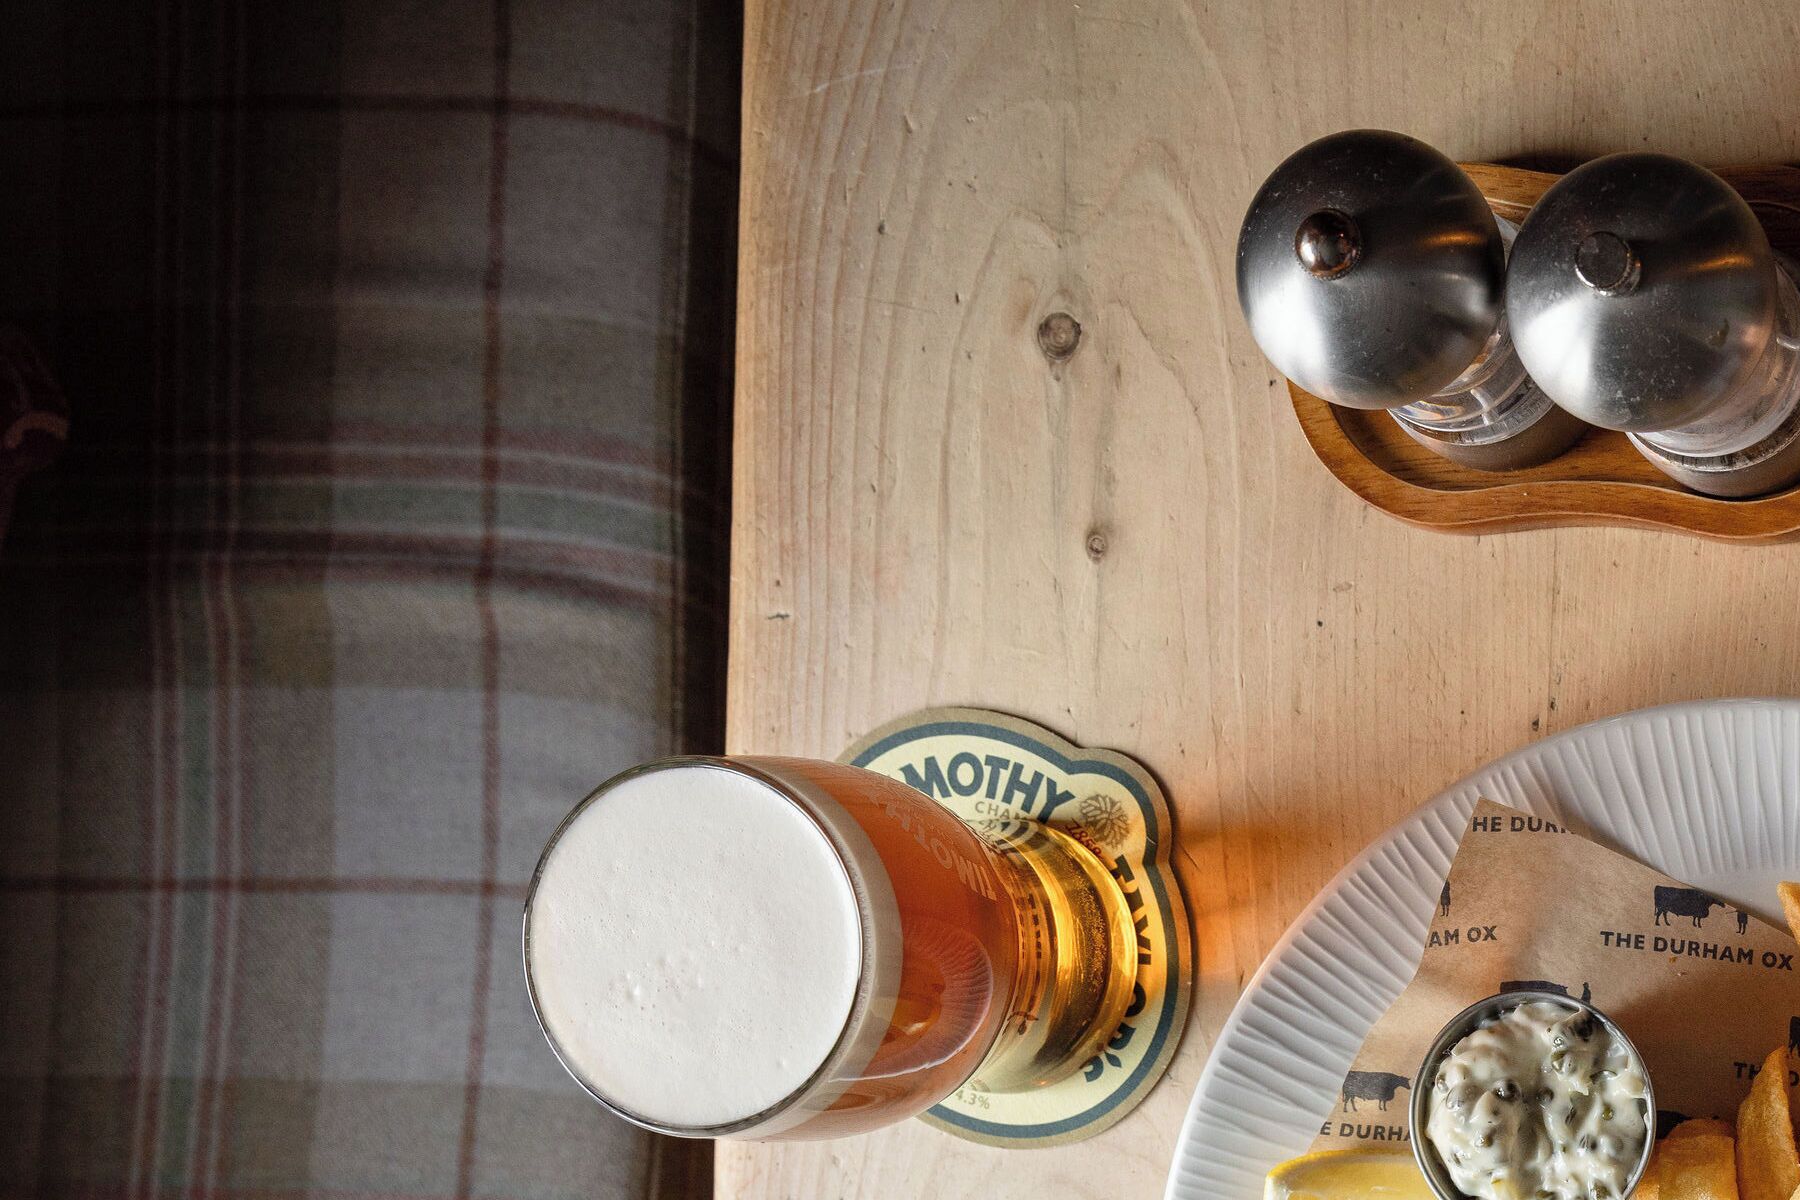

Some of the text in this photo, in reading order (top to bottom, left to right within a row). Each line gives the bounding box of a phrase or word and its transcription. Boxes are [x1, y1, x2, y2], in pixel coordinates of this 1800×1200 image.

[898, 752, 1076, 824] MOTHY
[1427, 925, 1498, 948] AM OX
[1600, 930, 1795, 970] THE DURHAM OX
